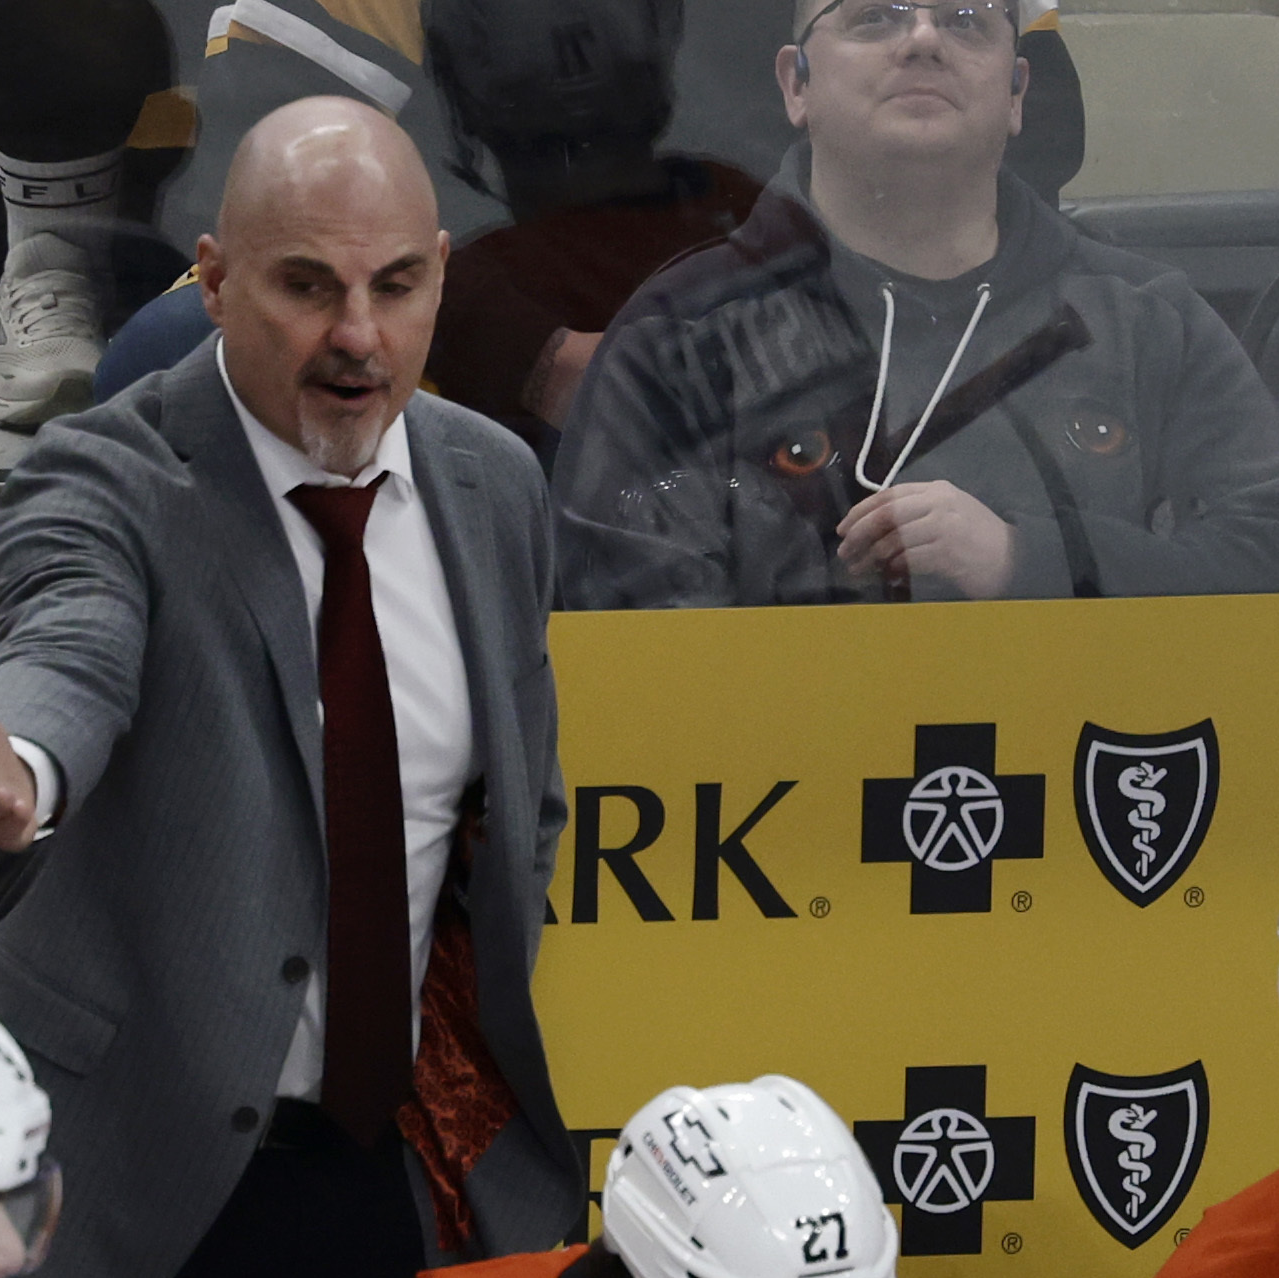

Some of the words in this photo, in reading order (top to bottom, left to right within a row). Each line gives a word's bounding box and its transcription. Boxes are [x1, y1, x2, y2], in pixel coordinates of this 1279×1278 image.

[544, 780, 800, 925] RK
[641, 1131, 697, 1206] CHEVROLET
[795, 1212, 849, 1264] 27
